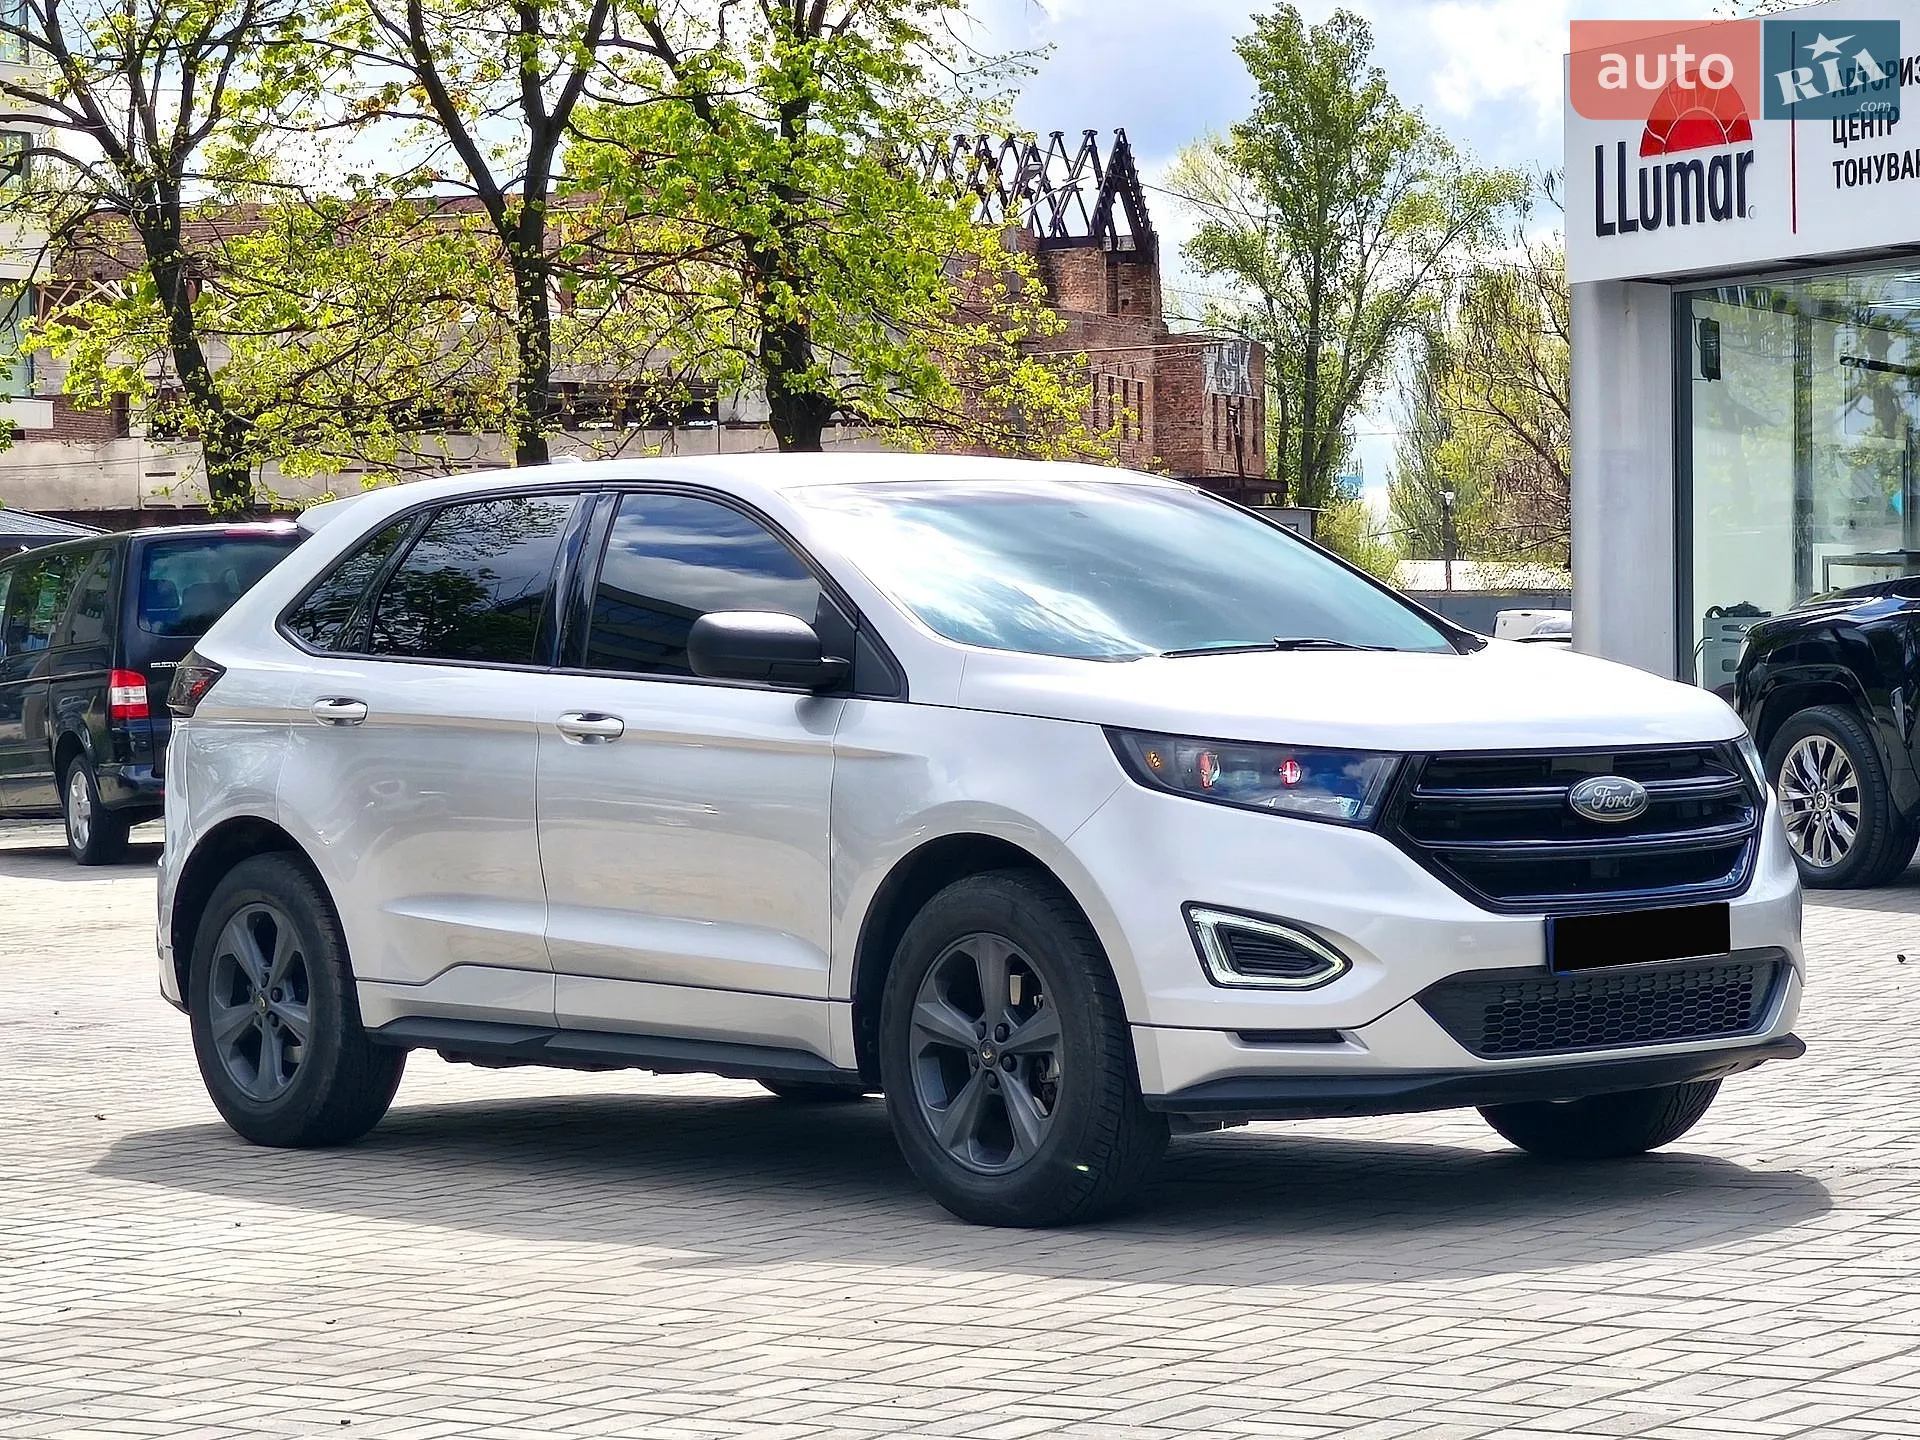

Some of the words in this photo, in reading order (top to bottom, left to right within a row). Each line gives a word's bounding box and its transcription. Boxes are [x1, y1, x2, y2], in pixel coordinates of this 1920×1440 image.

[1832, 106, 1900, 149] ЦЕНТР
[1595, 141, 1754, 237] LLumar
[1591, 785, 1636, 810] Ford
